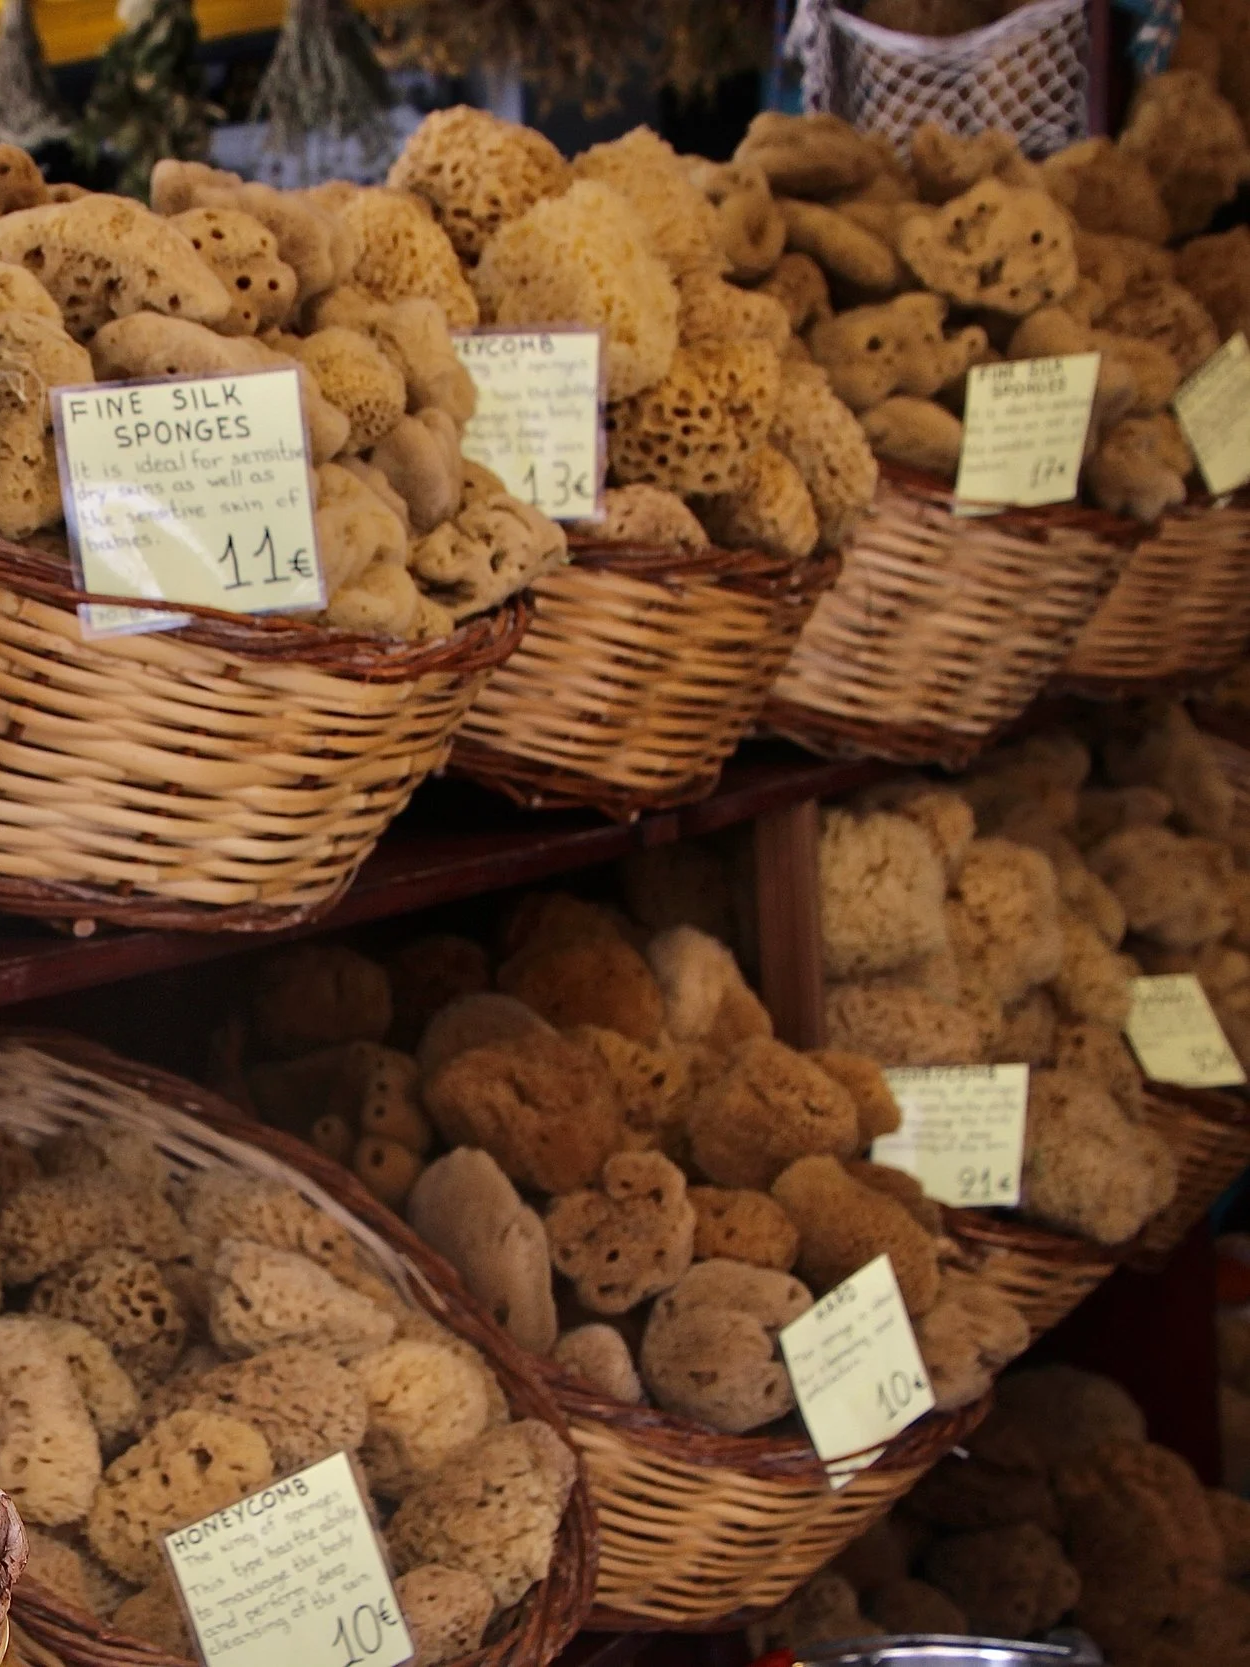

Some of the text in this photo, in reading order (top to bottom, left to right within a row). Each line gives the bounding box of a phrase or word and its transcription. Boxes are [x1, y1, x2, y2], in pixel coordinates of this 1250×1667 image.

[71, 384, 242, 423] FINE SILK
[115, 416, 251, 448] SPONGES
[73, 461, 91, 479] It
[102, 461, 122, 478] is
[135, 450, 186, 473] ideal
[192, 448, 223, 470] for
[78, 482, 107, 506] dry
[172, 479, 195, 493] as
[206, 468, 242, 488] well
[250, 469, 274, 485] as
[275, 487, 300, 508] of
[218, 526, 314, 590] 11€
[172, 1477, 309, 1554] HONEYCOMB
[332, 1597, 398, 1667] 10€
